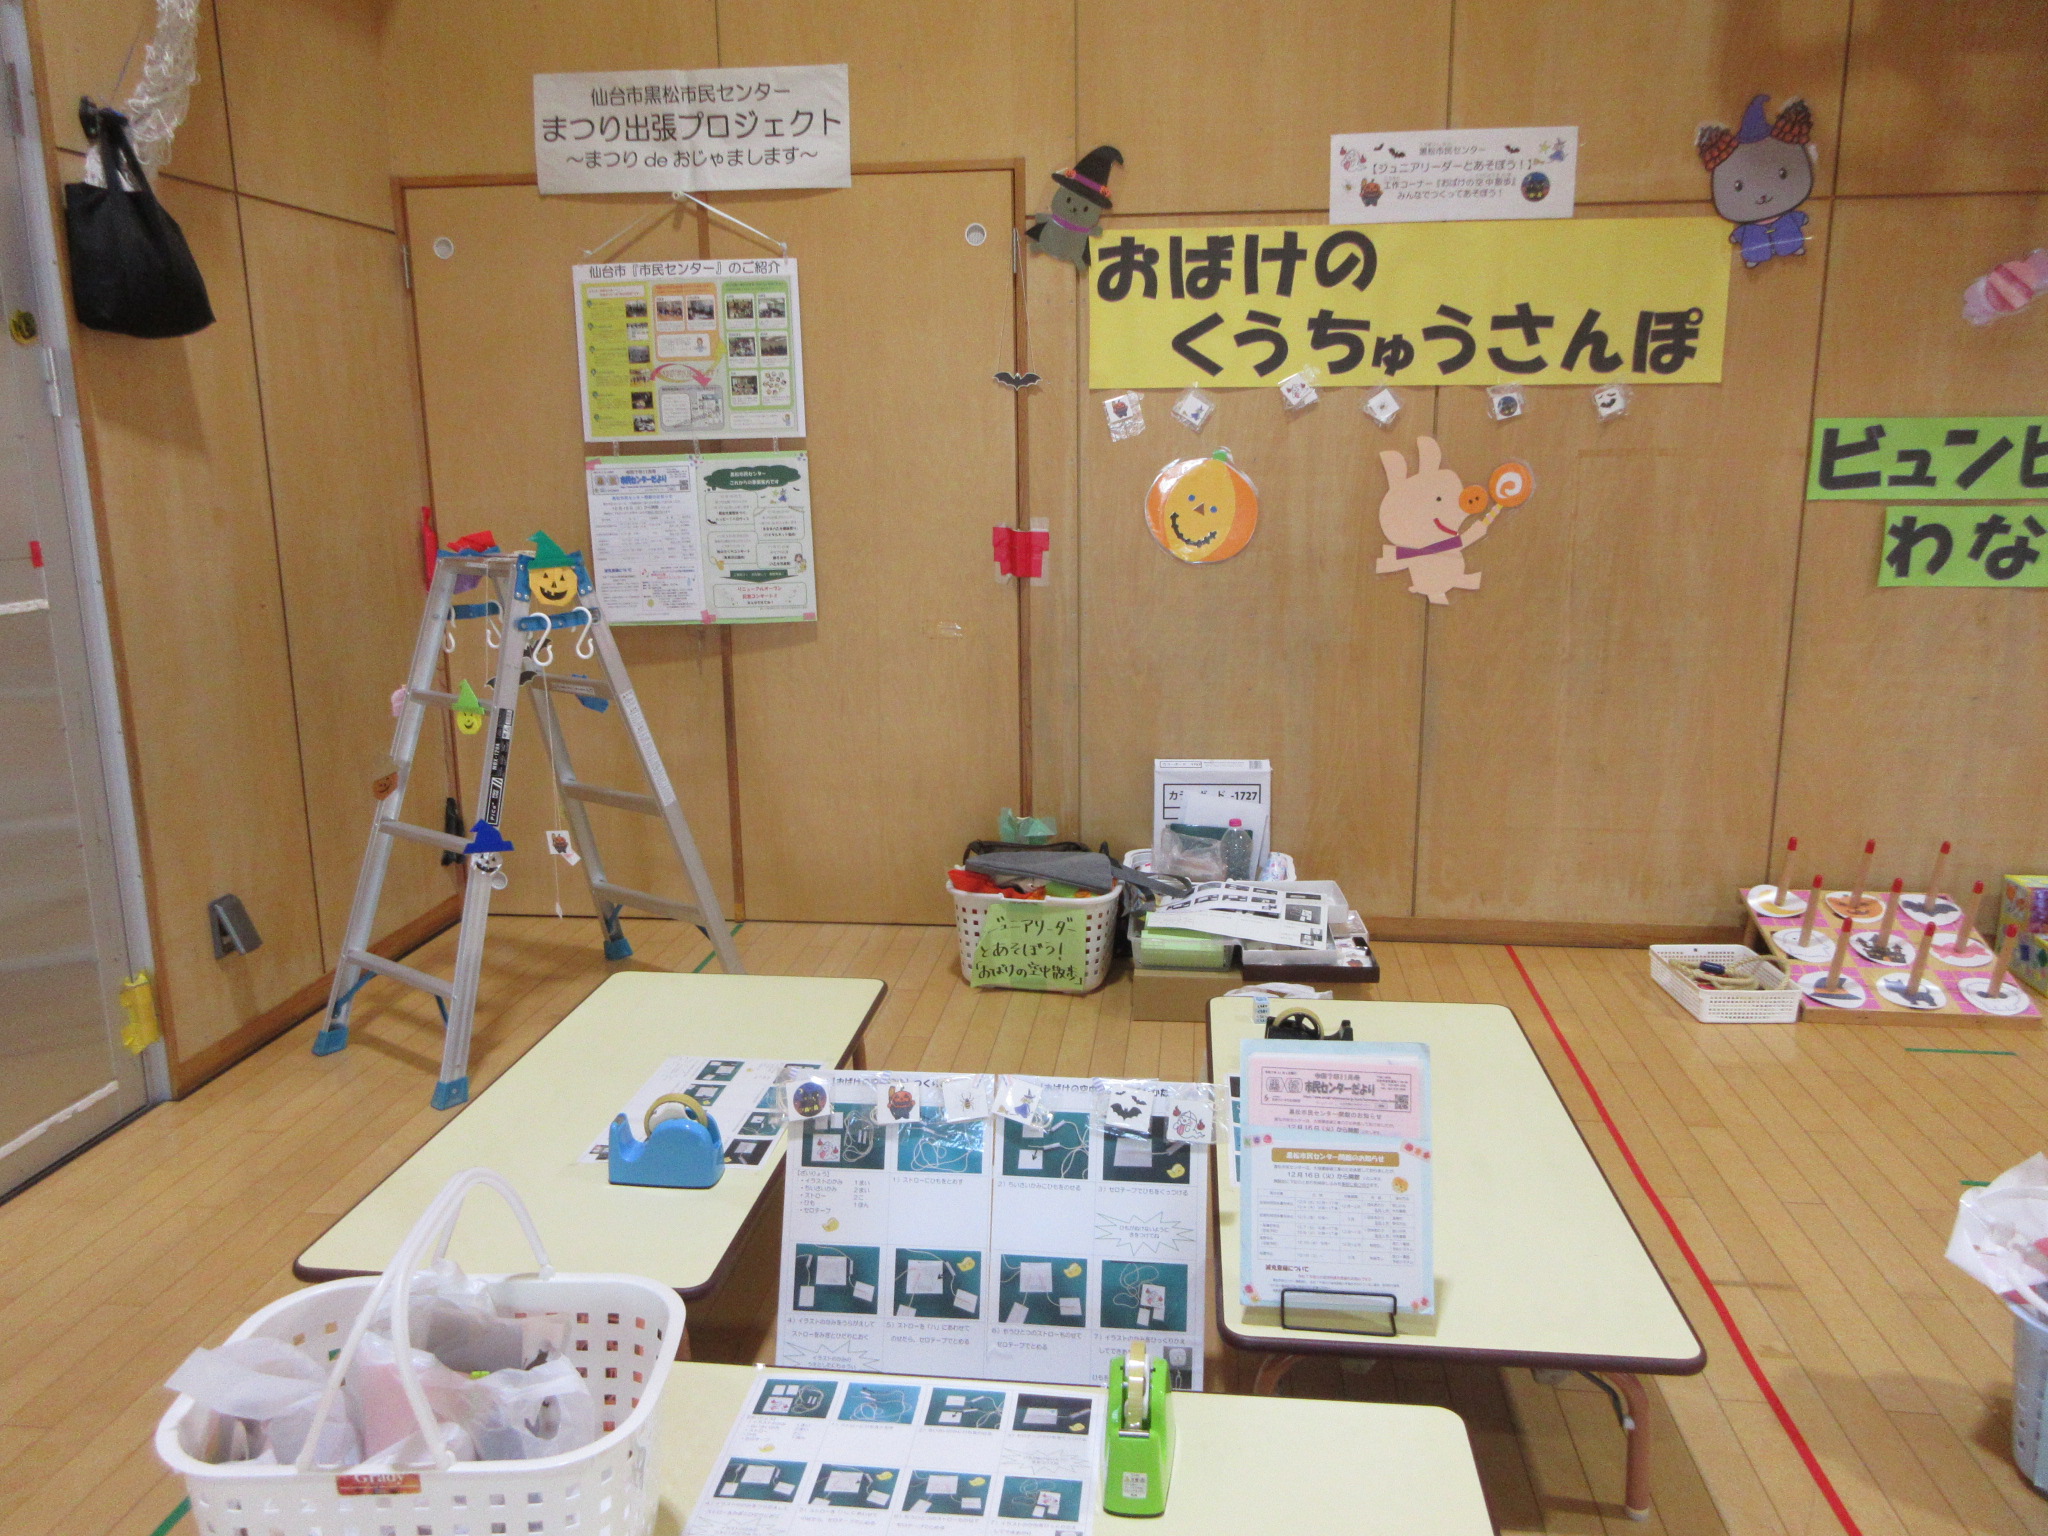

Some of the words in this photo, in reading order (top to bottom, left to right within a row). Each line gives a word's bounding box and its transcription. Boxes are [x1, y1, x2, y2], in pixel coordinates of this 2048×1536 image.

[591, 82, 790, 106] 仙台市黒松市民センター
[542, 108, 841, 143] まつり出張プロジェクト
[590, 260, 780, 279] 仙台市『市民センター』のご紹介
[1097, 230, 1377, 302] おばけの
[1171, 302, 1704, 378] くうちゅうさんぽ
[1885, 513, 2048, 581] わな
[988, 916, 1076, 936] ジュニアリーダー
[1305, 1080, 1375, 1096] 市民センターだより
